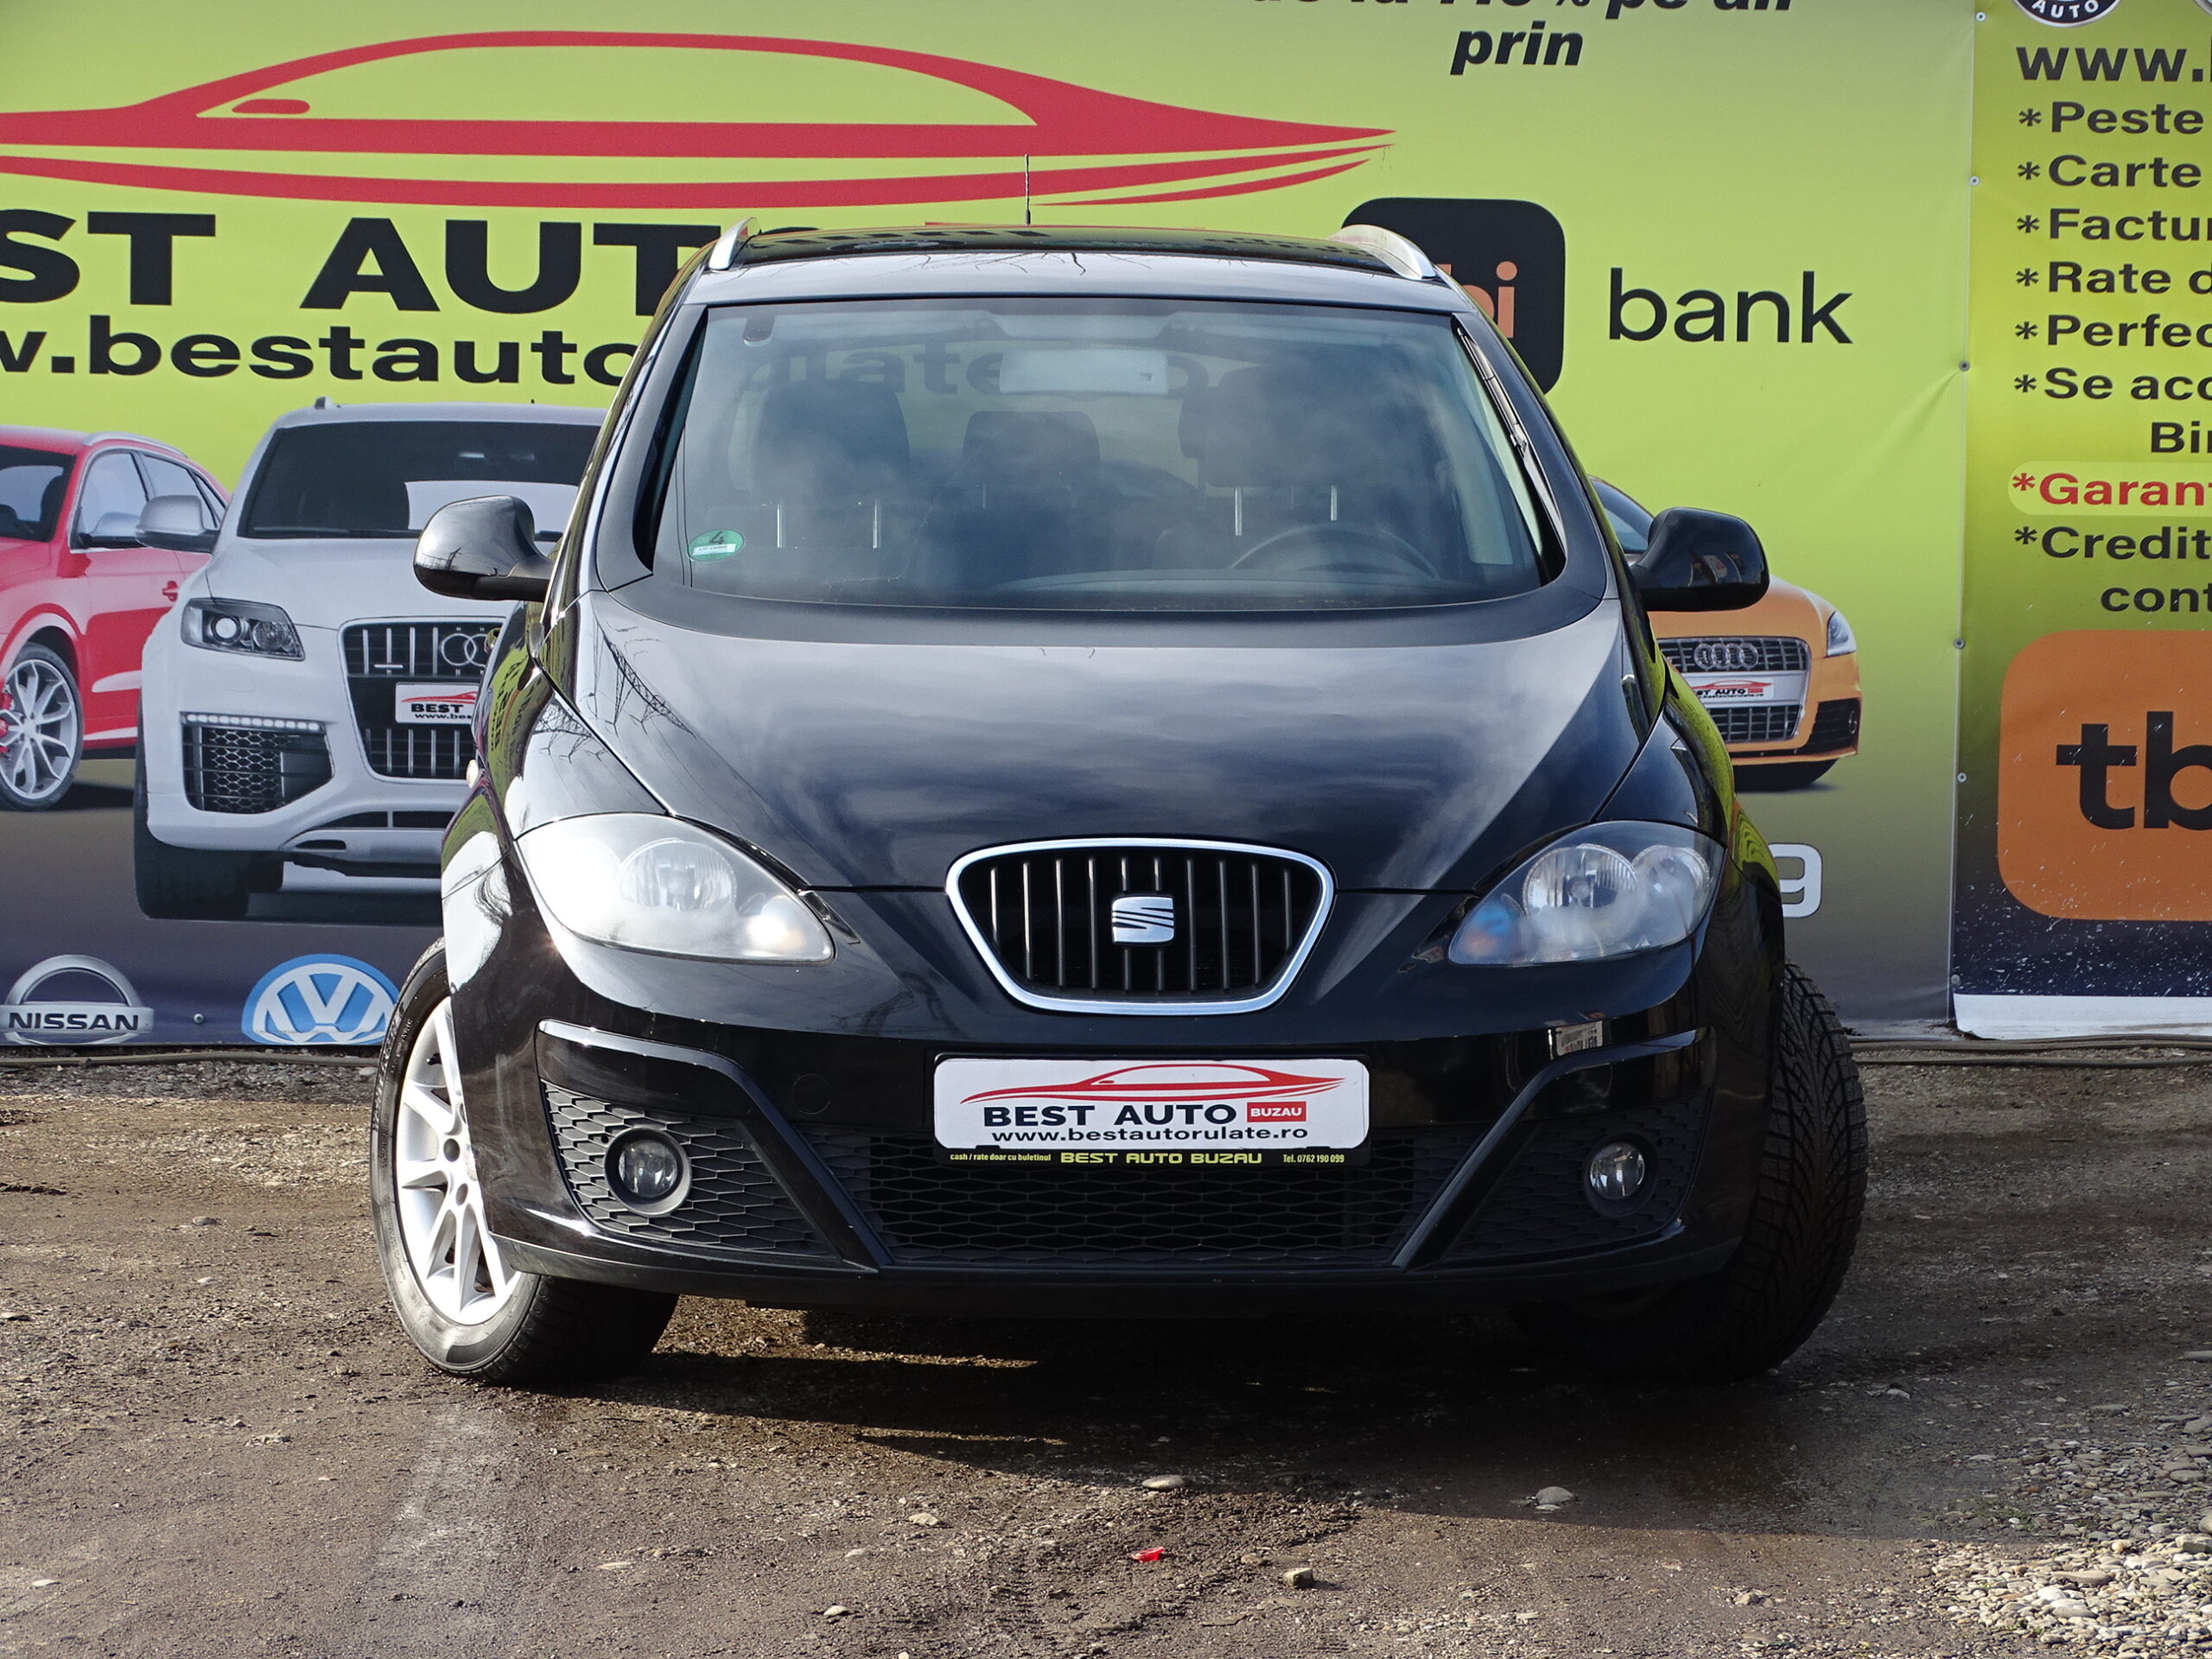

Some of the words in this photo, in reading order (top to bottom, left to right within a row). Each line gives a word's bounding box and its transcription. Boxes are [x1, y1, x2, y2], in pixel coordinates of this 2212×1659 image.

[2031, 0, 2100, 18] AUTO
[1450, 20, 1584, 75] prin
[2016, 35, 2212, 82] www.
[1609, 267, 1854, 344] bank
[2151, 420, 2212, 454] Bi
[410, 703, 464, 713] BEST
[8, 1012, 139, 1032] NISSAN
[983, 1105, 1096, 1127] BEST
[1113, 1104, 1237, 1126] AUTO
[1250, 1107, 1303, 1117] BUZAU
[991, 1127, 1308, 1141] www.bestautorulate.ro
[1060, 1152, 1119, 1164] BEST
[1126, 1152, 1183, 1164] AUTO
[1190, 1153, 1262, 1164] BUZAU
[1283, 1154, 1296, 1163] Tel.
[1297, 1154, 1315, 1163] 0762
[1316, 1154, 1330, 1163] 190
[1330, 1154, 1344, 1163] 099
